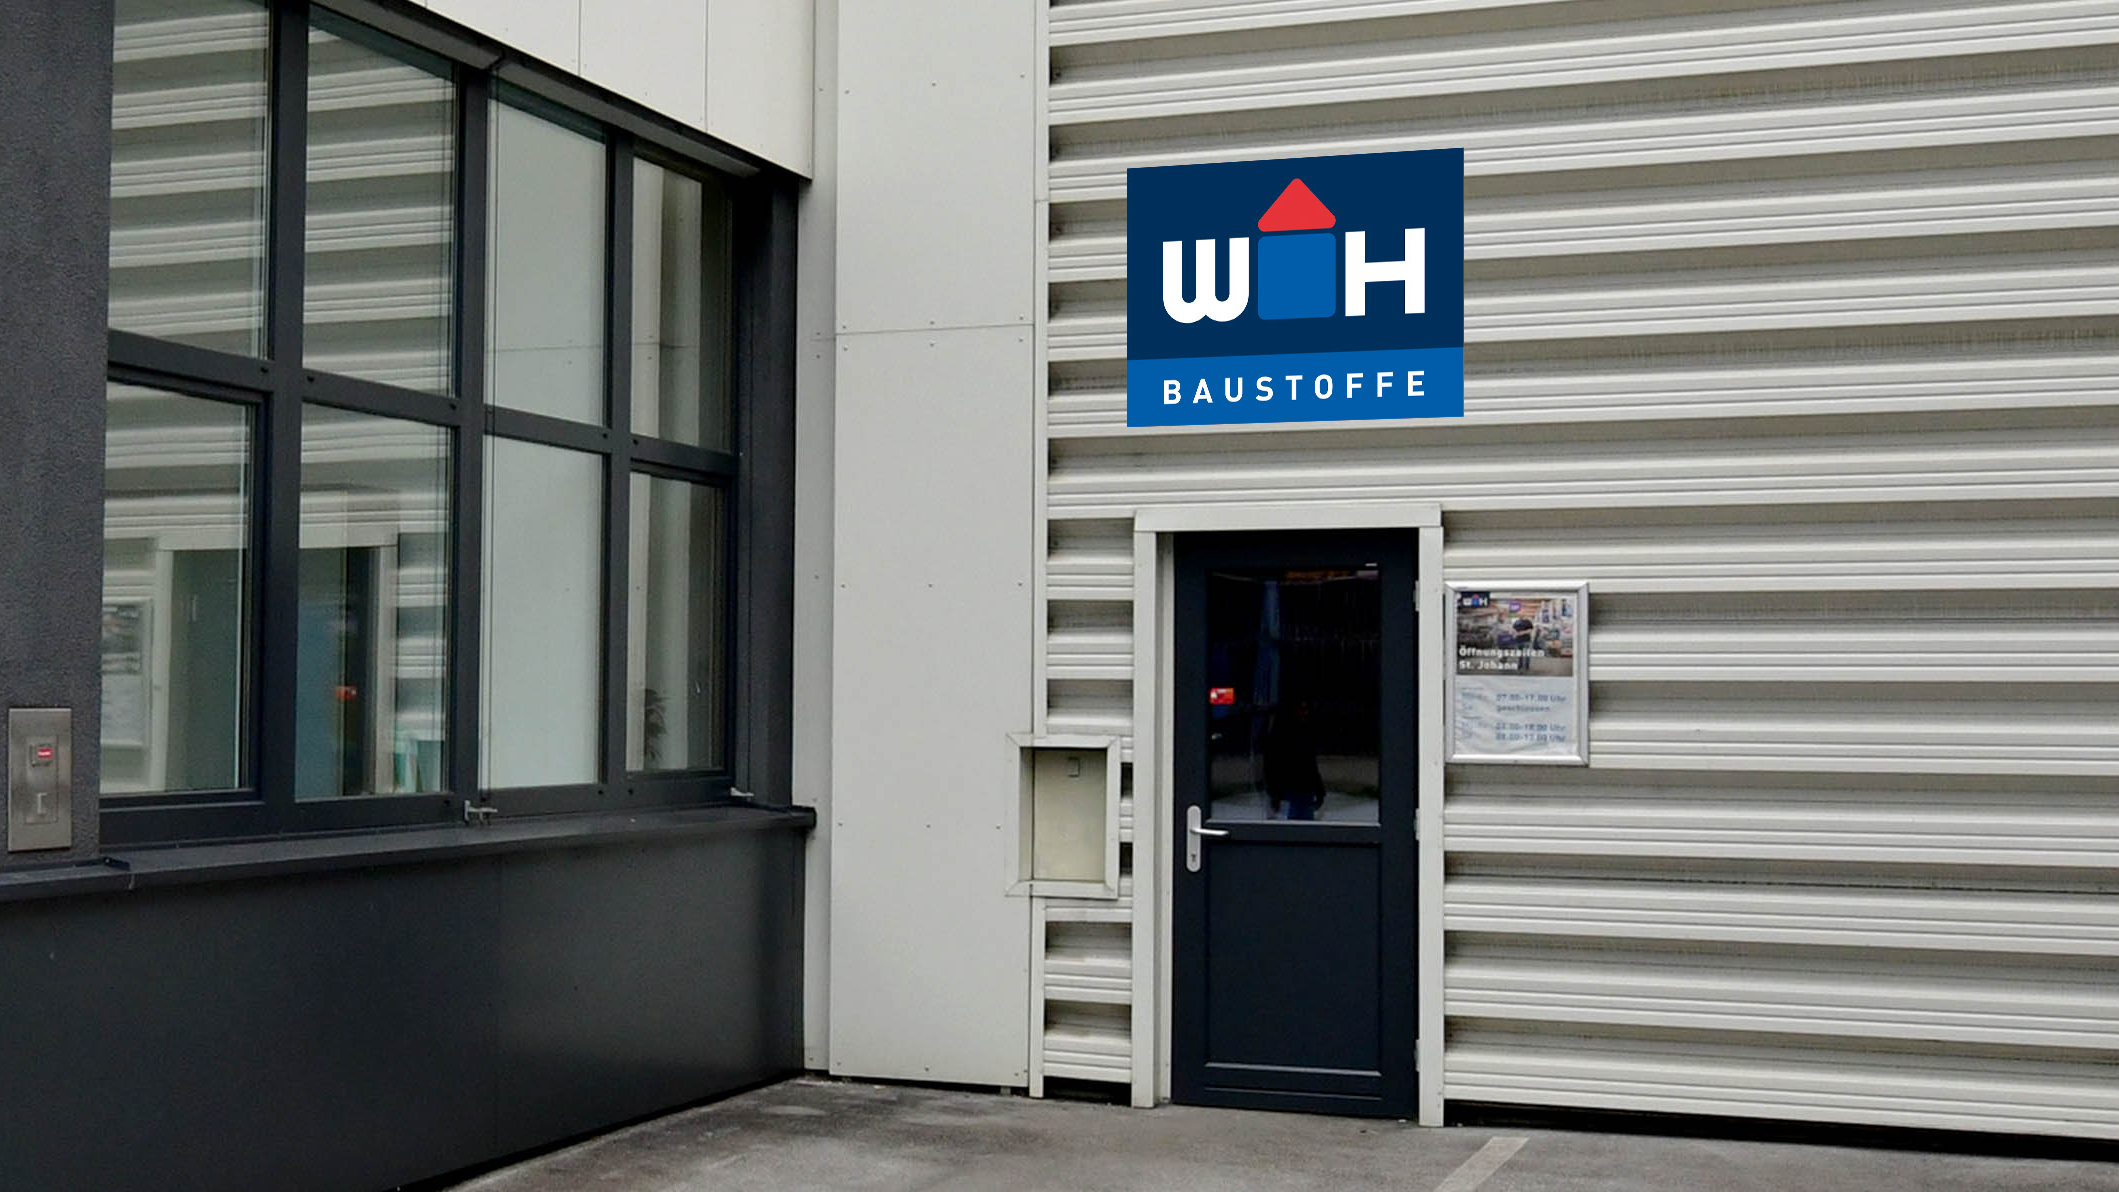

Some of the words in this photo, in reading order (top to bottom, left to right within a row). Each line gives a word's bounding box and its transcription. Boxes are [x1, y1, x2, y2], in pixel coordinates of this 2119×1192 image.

[1163, 370, 1425, 405] BAUSTOFFE
[1459, 645, 1545, 658] Öffnungszeiten
[1459, 660, 1475, 670] St.
[1479, 660, 1519, 671] Johann
